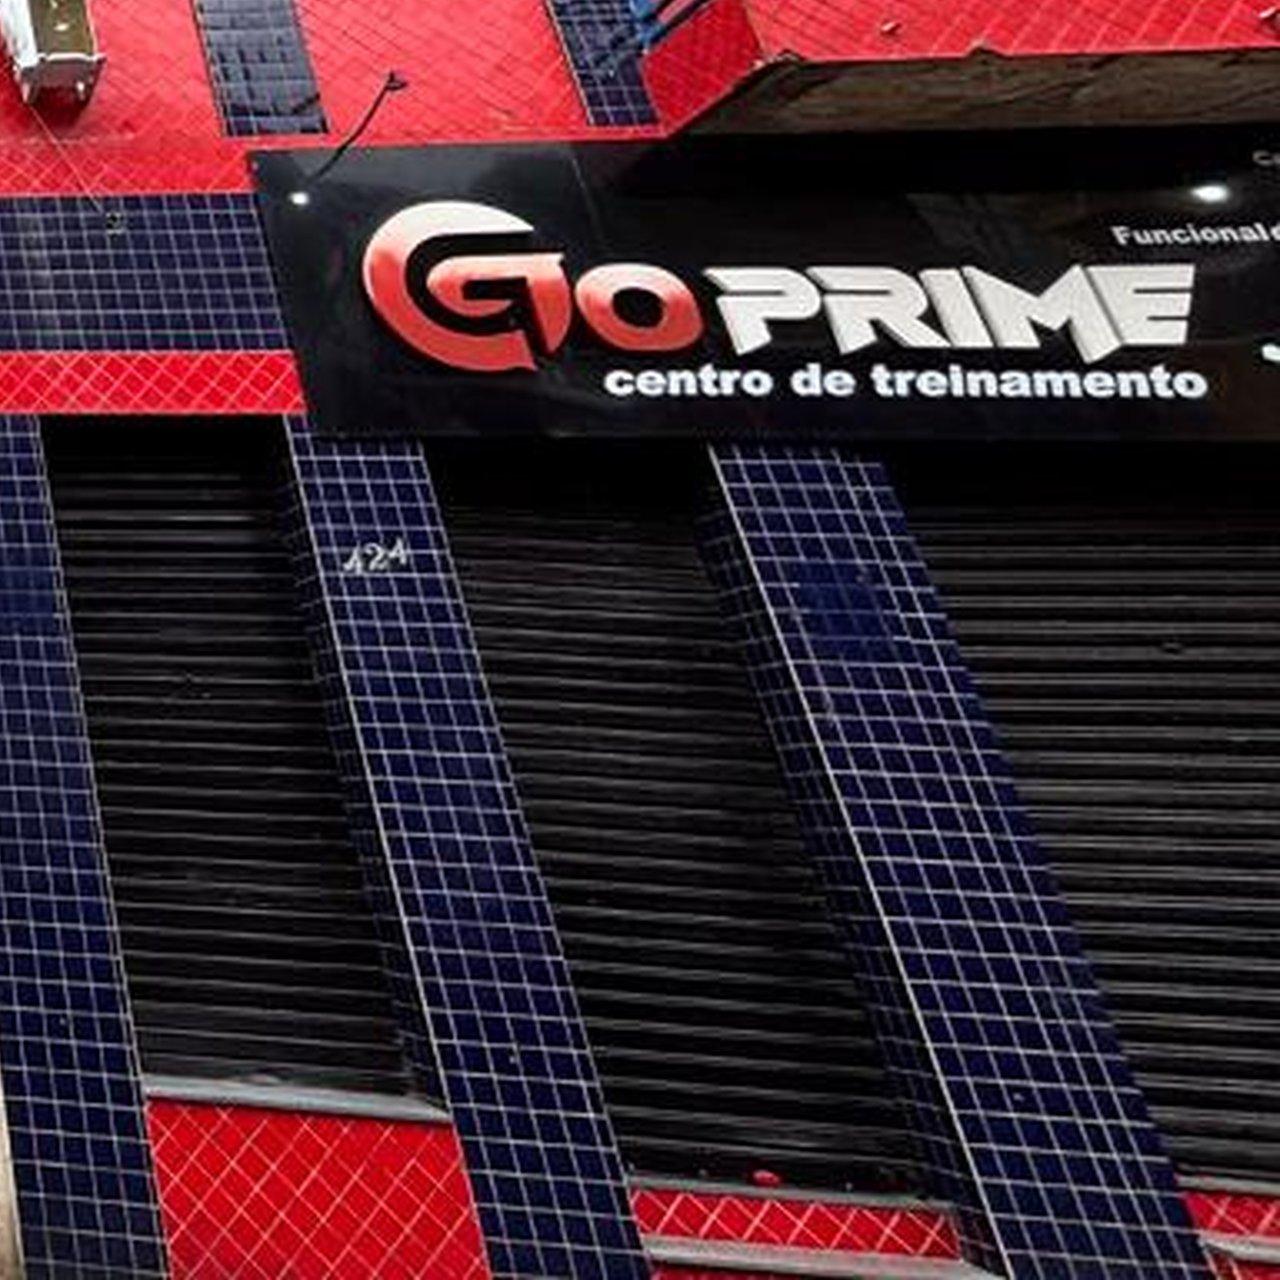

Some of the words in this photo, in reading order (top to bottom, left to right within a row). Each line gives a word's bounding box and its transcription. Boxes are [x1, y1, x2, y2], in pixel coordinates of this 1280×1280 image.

[605, 363, 772, 398] centro
[790, 363, 857, 398] de
[871, 363, 1208, 399] treinamento
[342, 537, 407, 574] 424
